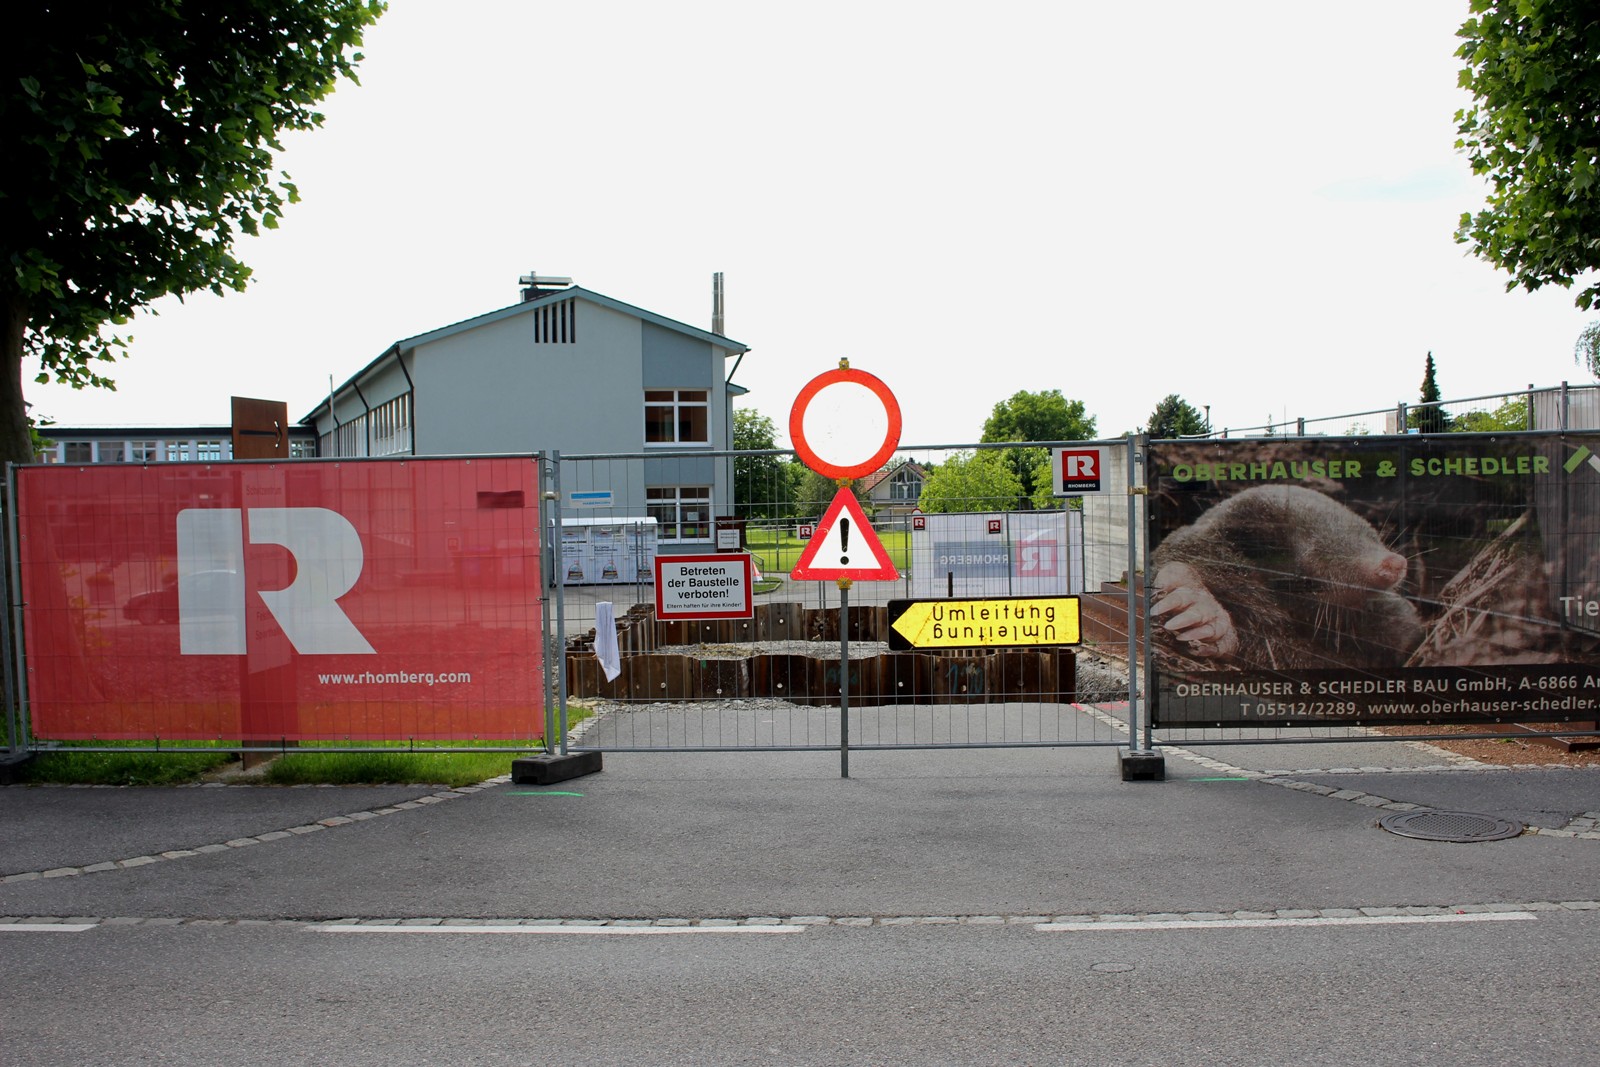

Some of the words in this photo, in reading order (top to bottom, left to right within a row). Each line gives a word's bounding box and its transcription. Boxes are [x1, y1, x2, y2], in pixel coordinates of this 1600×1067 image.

[1067, 455, 1096, 477] R
[1172, 460, 1362, 483] OBERHAUSER
[1375, 459, 1397, 478] &
[1410, 455, 1550, 477] SCHEDLER
[680, 566, 726, 576] Betreten
[176, 507, 377, 656] R
[667, 578, 686, 588] der
[688, 577, 740, 587] Baustelle
[677, 588, 729, 599] verboten!
[932, 604, 1055, 623] Umleitung
[1559, 595, 1600, 617] Tie
[933, 623, 1056, 642] Umleitung
[318, 670, 471, 687] www.rhomberg.com
[1176, 681, 1294, 697] OBERHAUSER
[1299, 681, 1312, 695] &
[1318, 679, 1406, 695] SCHEDLER
[1412, 678, 1449, 693] BAU
[1455, 677, 1513, 692] GmbH,
[1518, 675, 1578, 691] A-6866
[1240, 703, 1250, 716] T
[1256, 702, 1361, 717] 05512/2289,
[1368, 695, 1600, 714] www.oberhauser-schedler.
